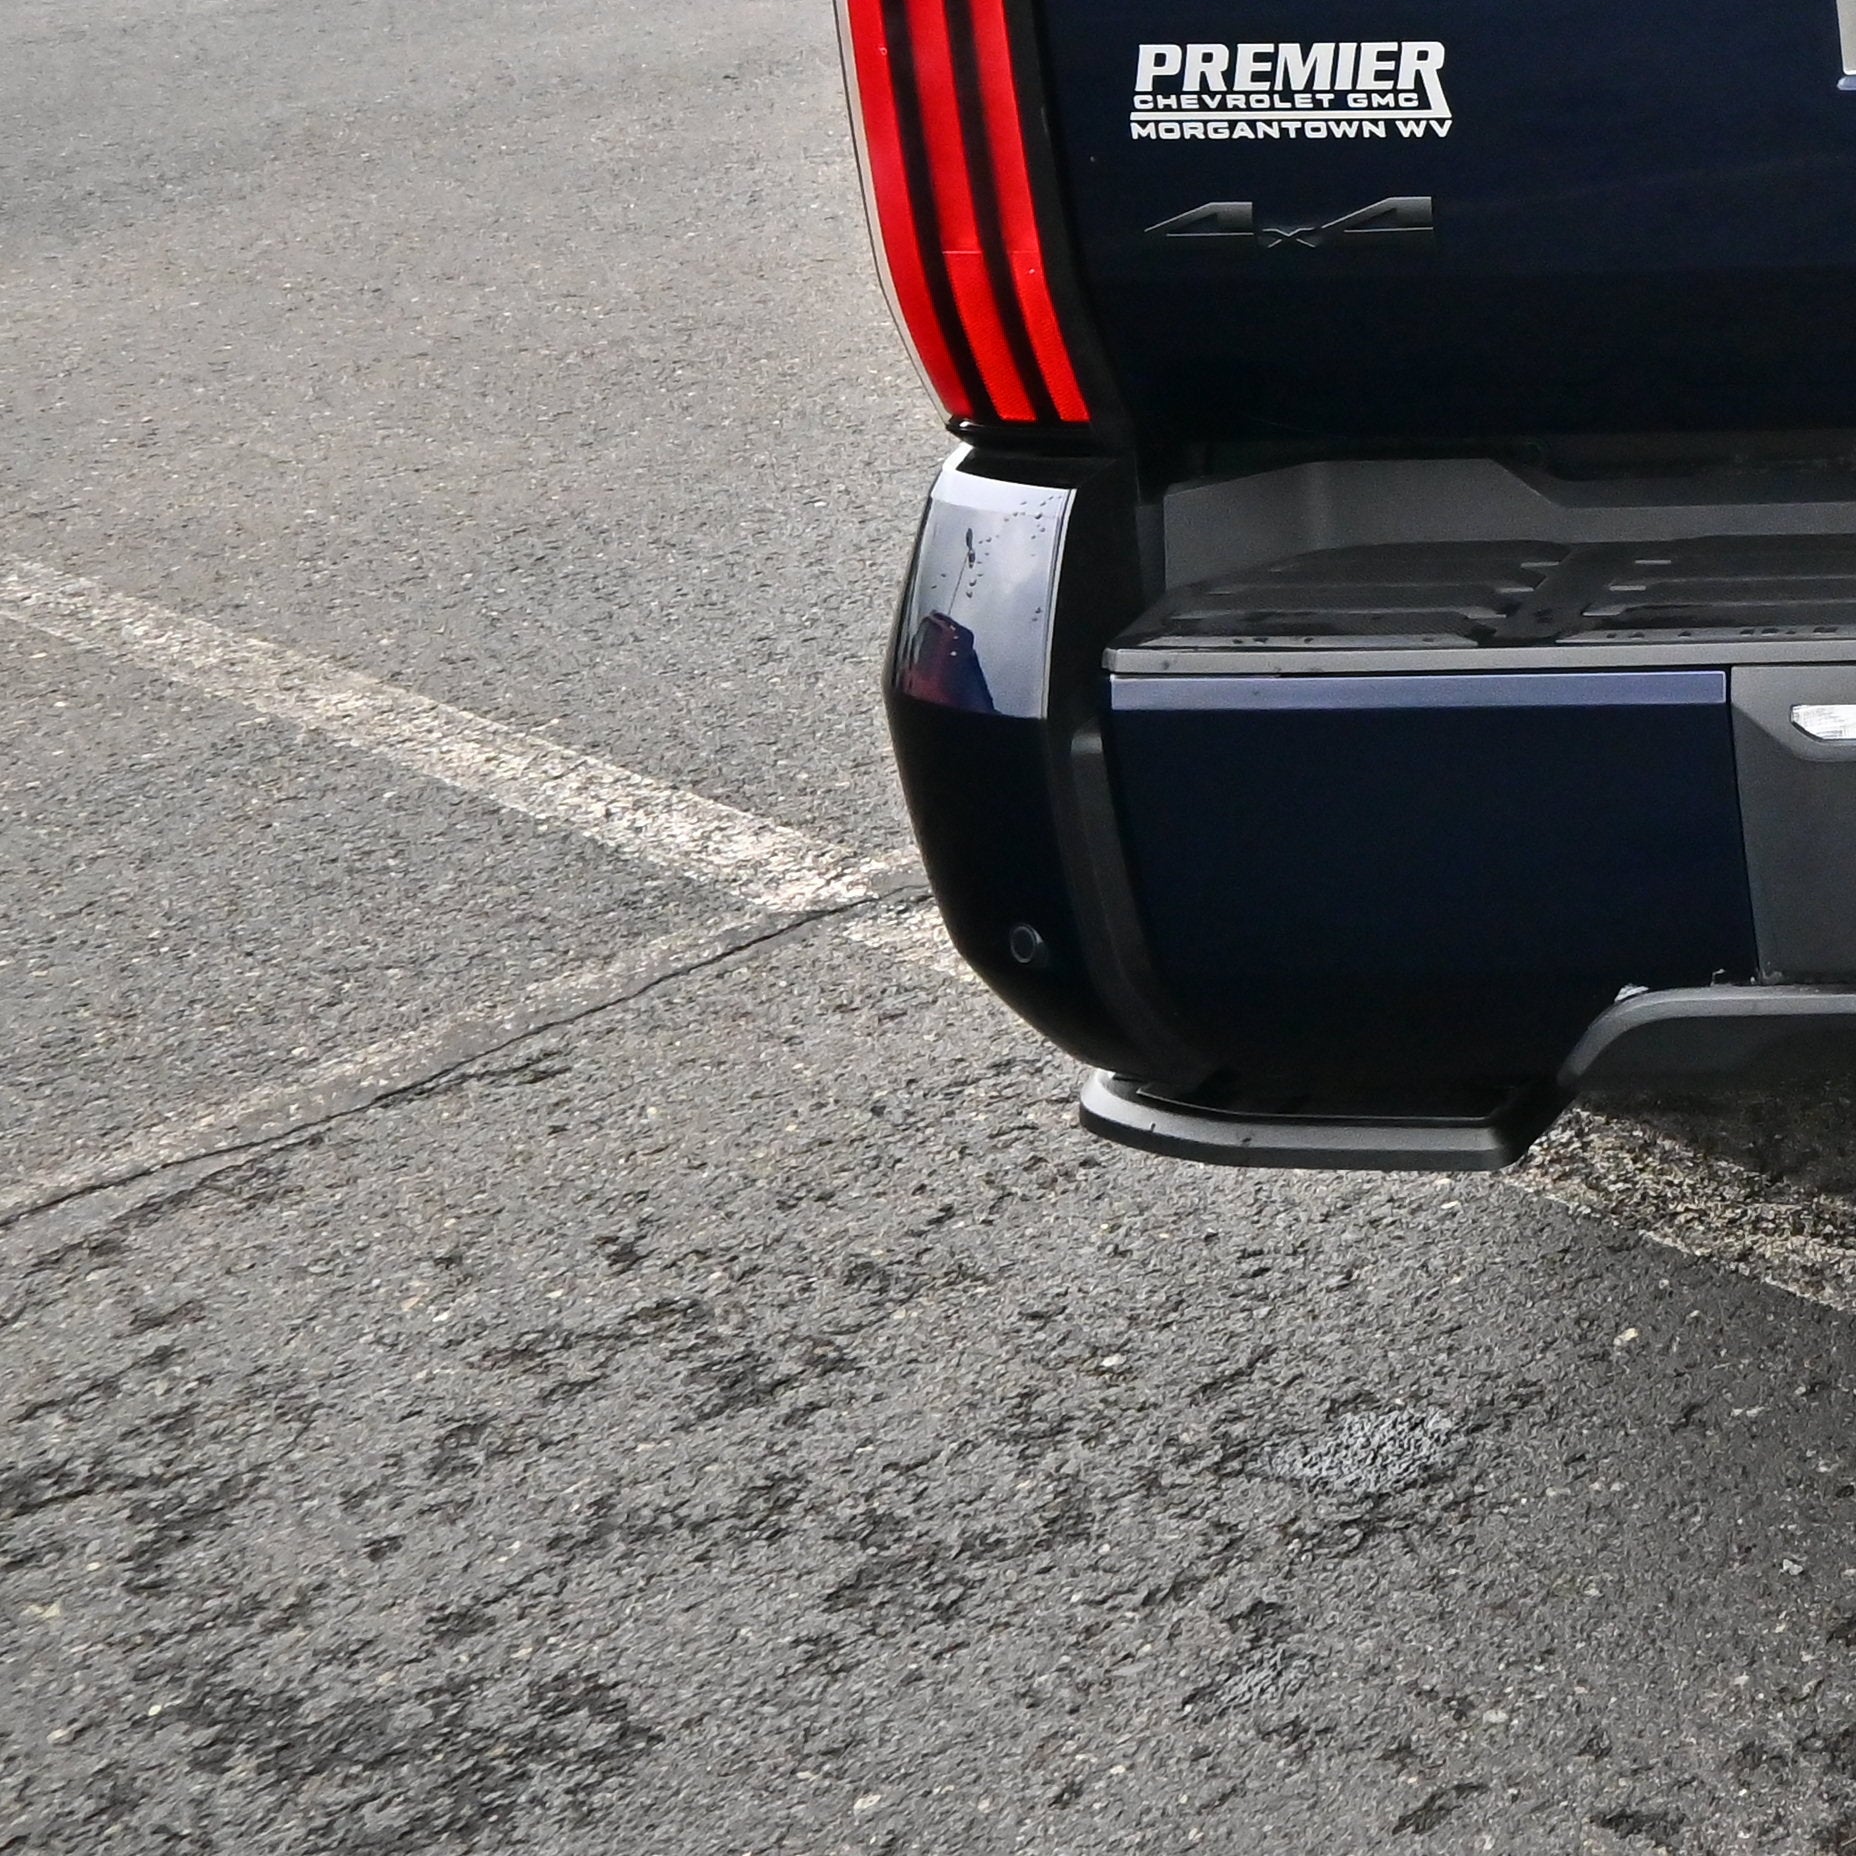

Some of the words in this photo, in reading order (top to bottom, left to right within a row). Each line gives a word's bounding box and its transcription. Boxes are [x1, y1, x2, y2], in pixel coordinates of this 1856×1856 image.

[1134, 41, 1452, 118] PREMIER
[1133, 92, 1335, 110] CHEVROLET
[1347, 92, 1419, 108] GMC
[1130, 120, 1386, 140] MORGANTOWN
[1396, 119, 1452, 138] WV
